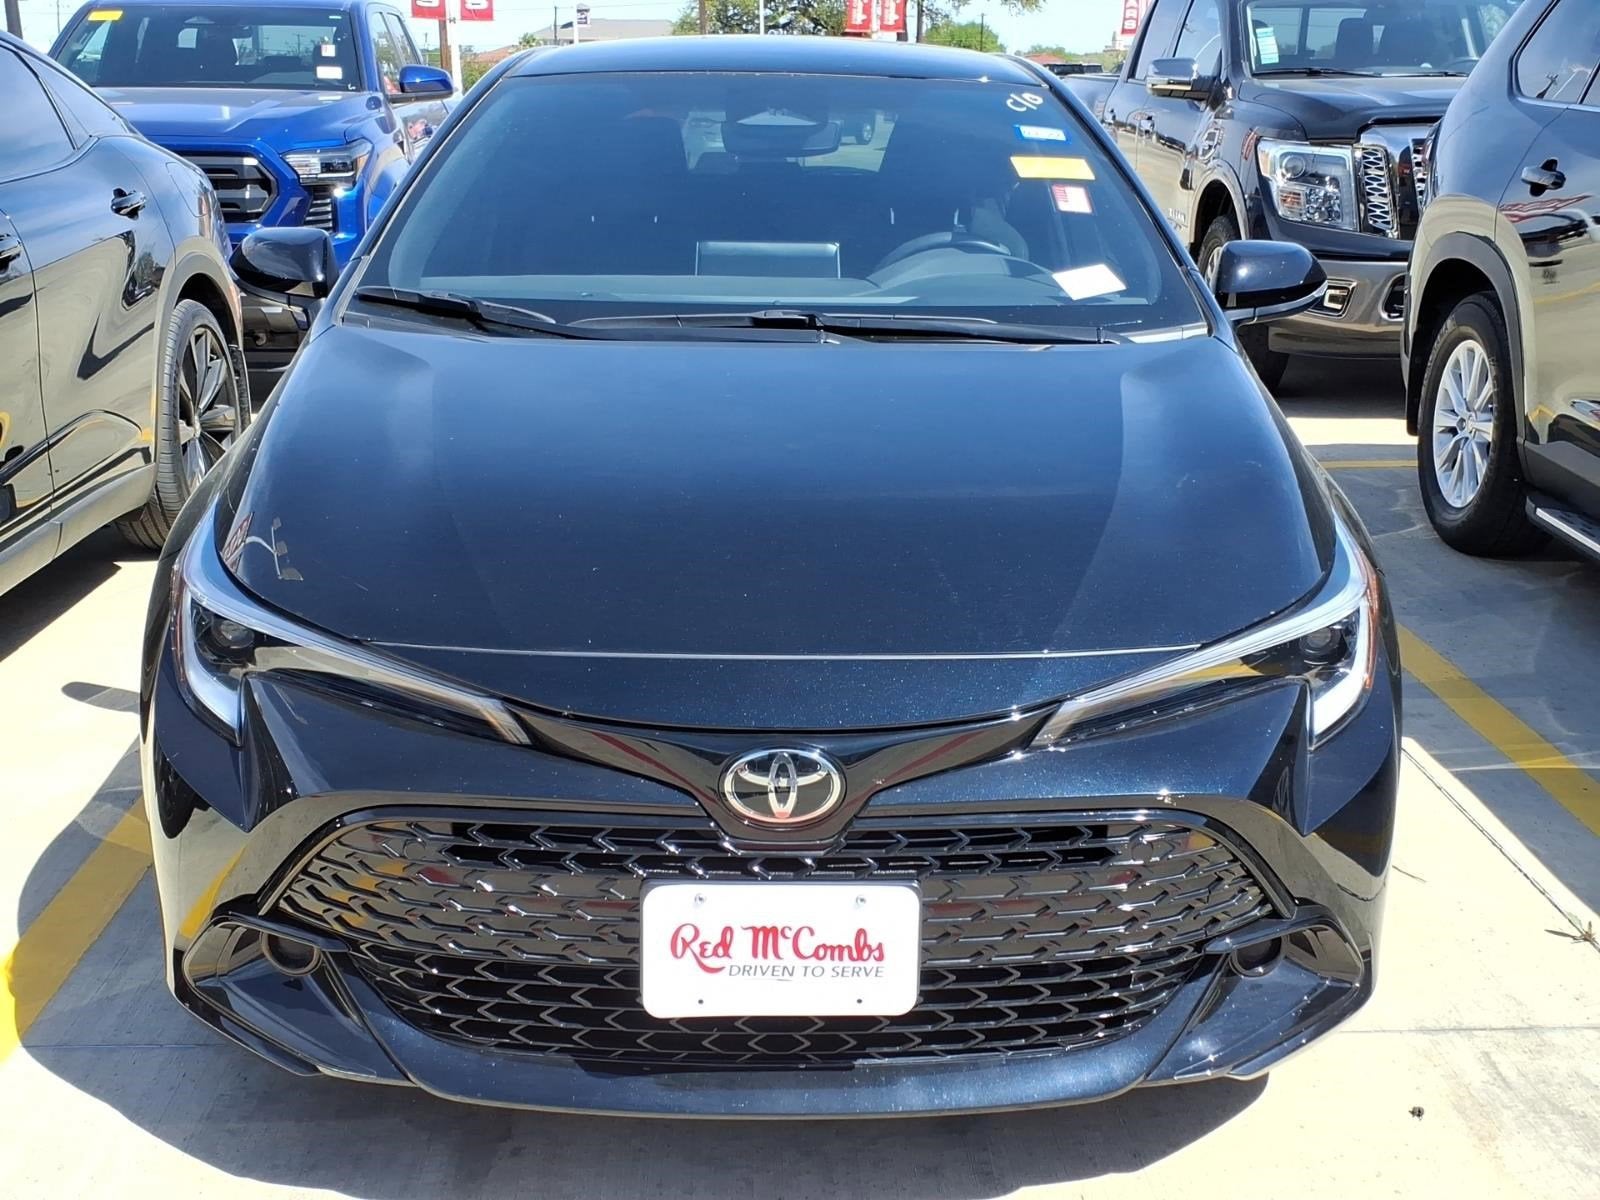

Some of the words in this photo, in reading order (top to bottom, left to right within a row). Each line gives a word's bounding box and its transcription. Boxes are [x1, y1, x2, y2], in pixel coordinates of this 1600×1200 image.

[671, 923, 733, 973] Red
[741, 926, 885, 962] McCombs
[729, 964, 795, 977] DRIVEN
[802, 965, 825, 978] TO
[831, 965, 885, 978] SERVE
